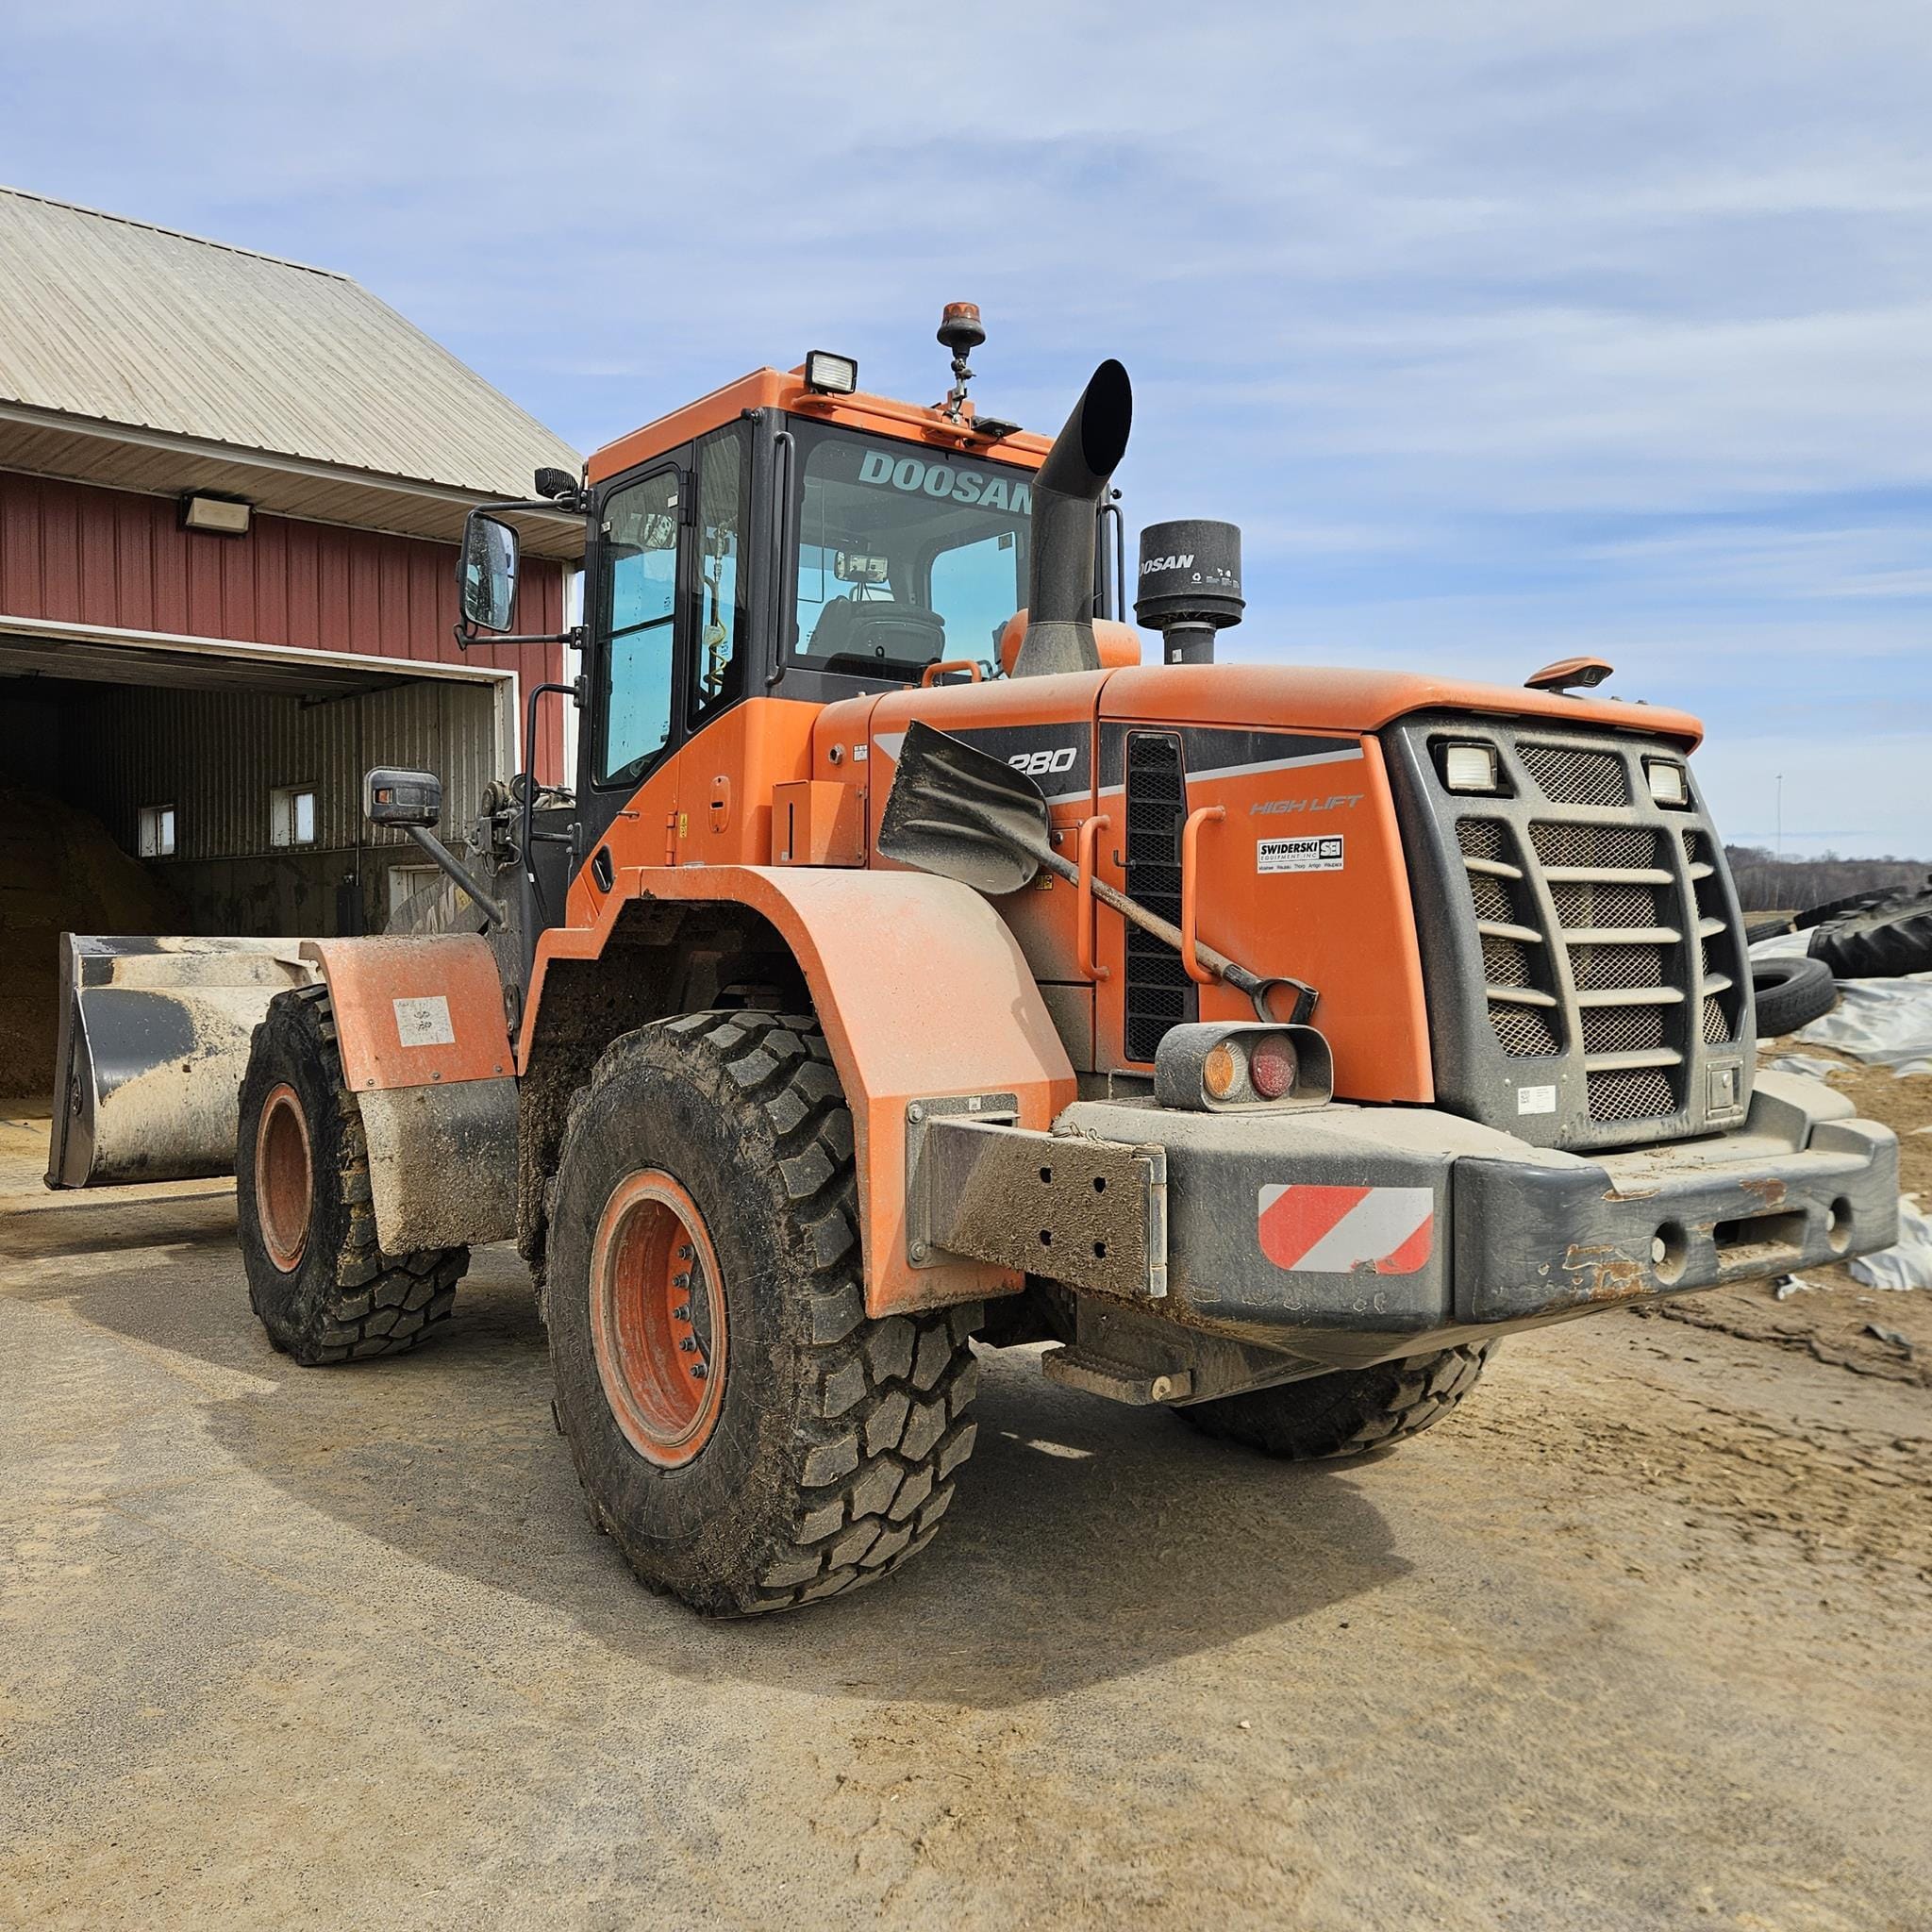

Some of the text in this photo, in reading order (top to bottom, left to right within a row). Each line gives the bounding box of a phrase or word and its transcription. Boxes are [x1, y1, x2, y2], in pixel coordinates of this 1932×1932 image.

[1008, 747, 1077, 775] 280
[1248, 793, 1365, 815] HIGH LIFT
[1260, 841, 1318, 855] SWIDERSKI
[1260, 853, 1300, 861] EQUIPMENT
